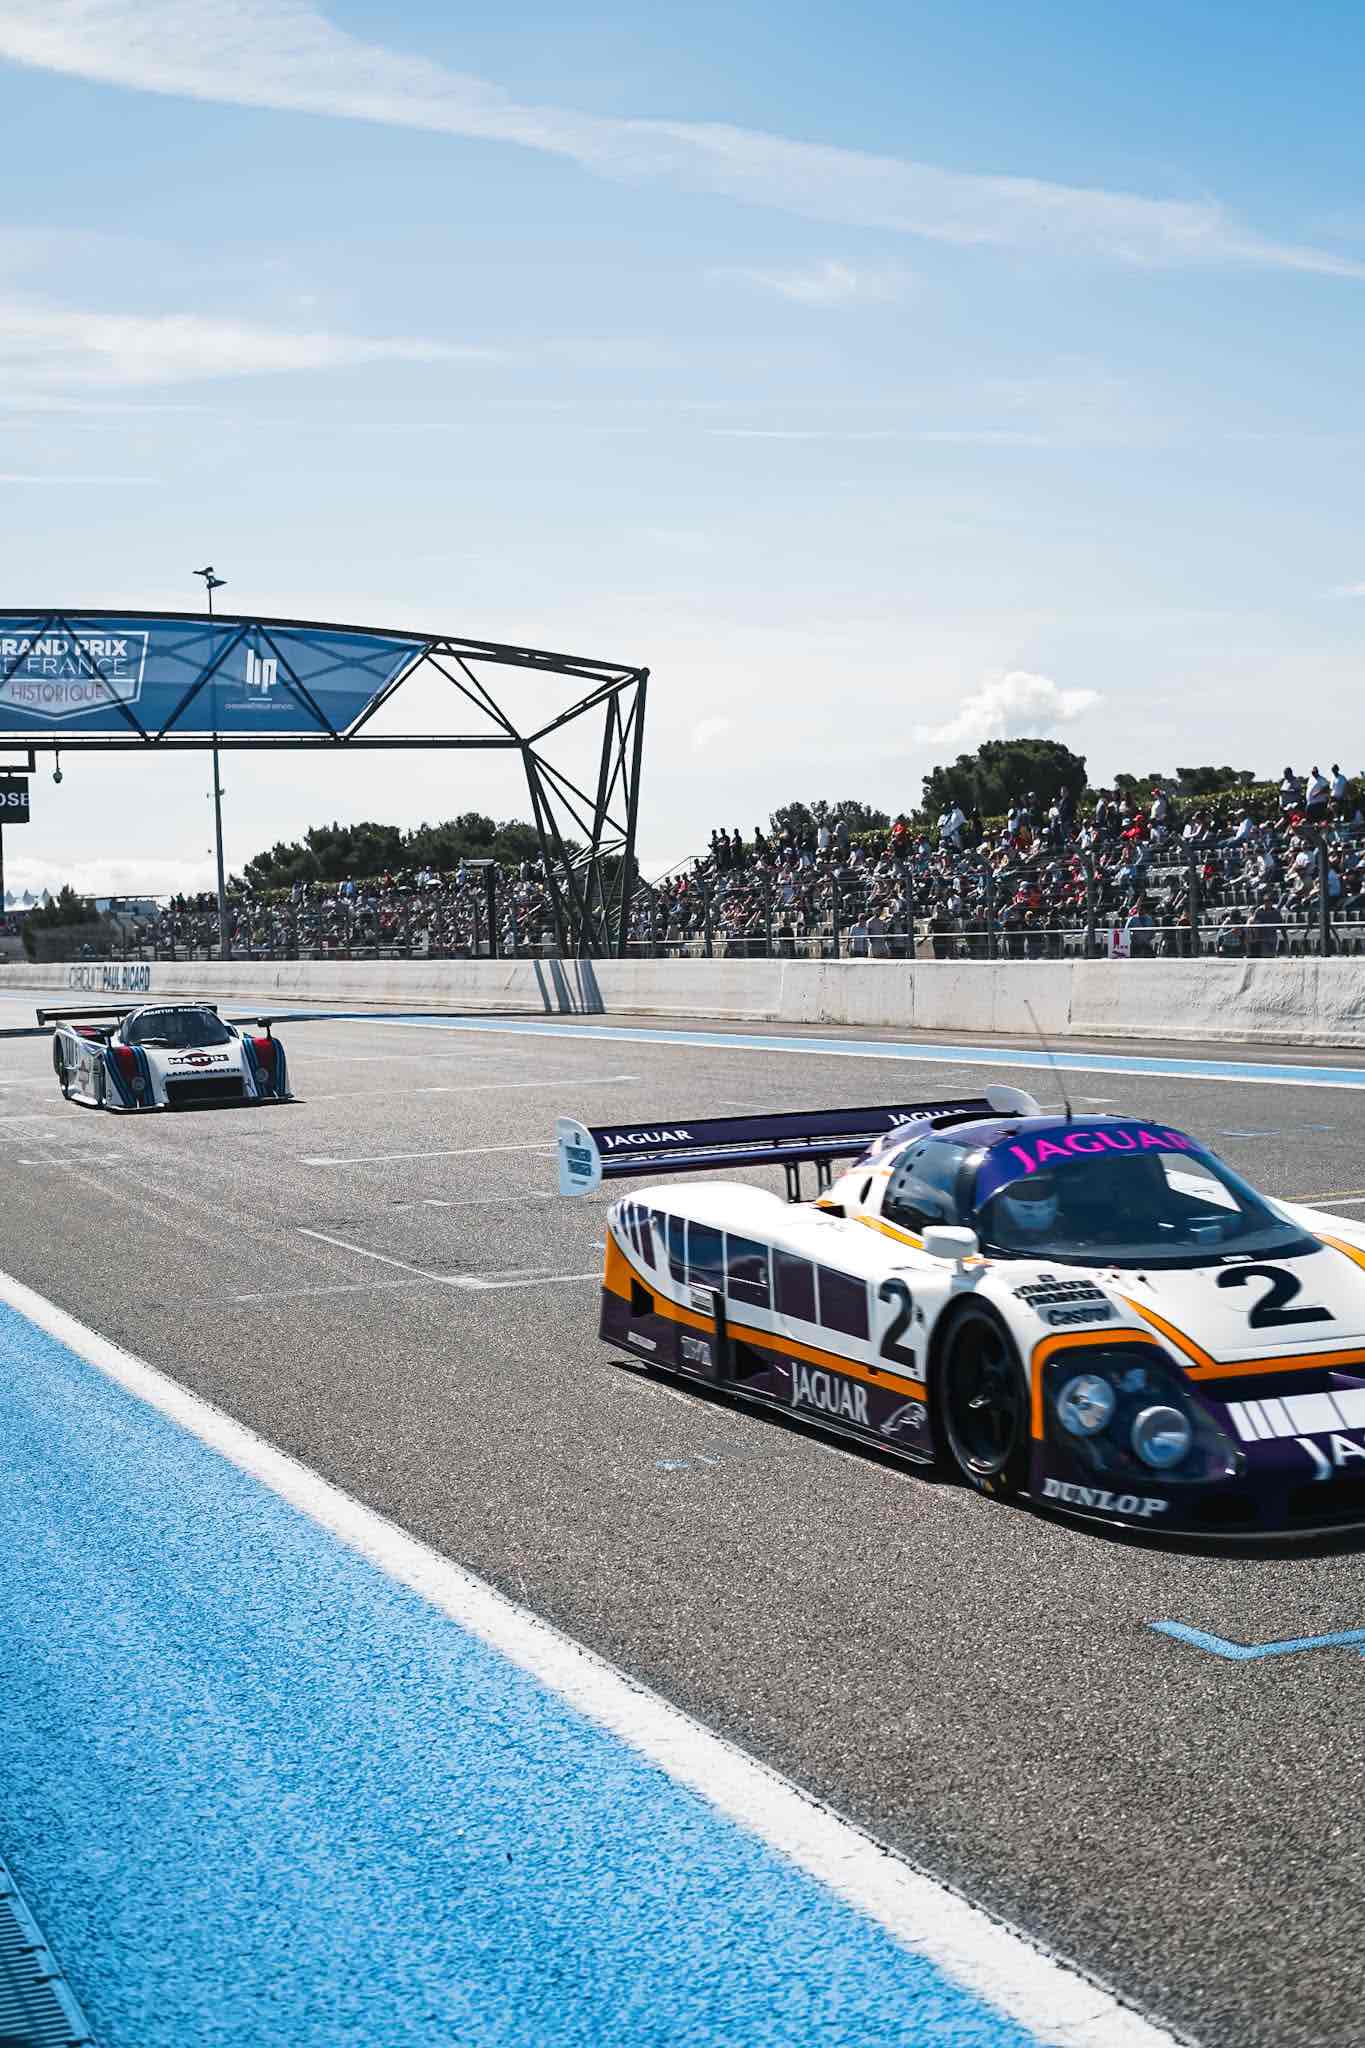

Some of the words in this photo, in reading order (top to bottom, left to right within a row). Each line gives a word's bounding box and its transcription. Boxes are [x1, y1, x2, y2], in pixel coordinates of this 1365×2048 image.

[0, 639, 69, 656] RAND
[75, 639, 127, 656] PRIX
[0, 658, 17, 674] E
[27, 657, 127, 675] FRANCE
[10, 683, 104, 701] HISTORIQUE
[103, 966, 121, 990] PAUL
[123, 966, 150, 991] RICARD
[169, 1056, 228, 1065] MARTIN
[603, 1130, 694, 1148] JAGUAR
[1009, 1129, 1199, 1174] JAGUAR
[1216, 1265, 1336, 1329] 2
[878, 1277, 915, 1370] 2
[791, 1362, 870, 1425] JAGUAR
[1041, 1478, 1168, 1517] DUNLOP
